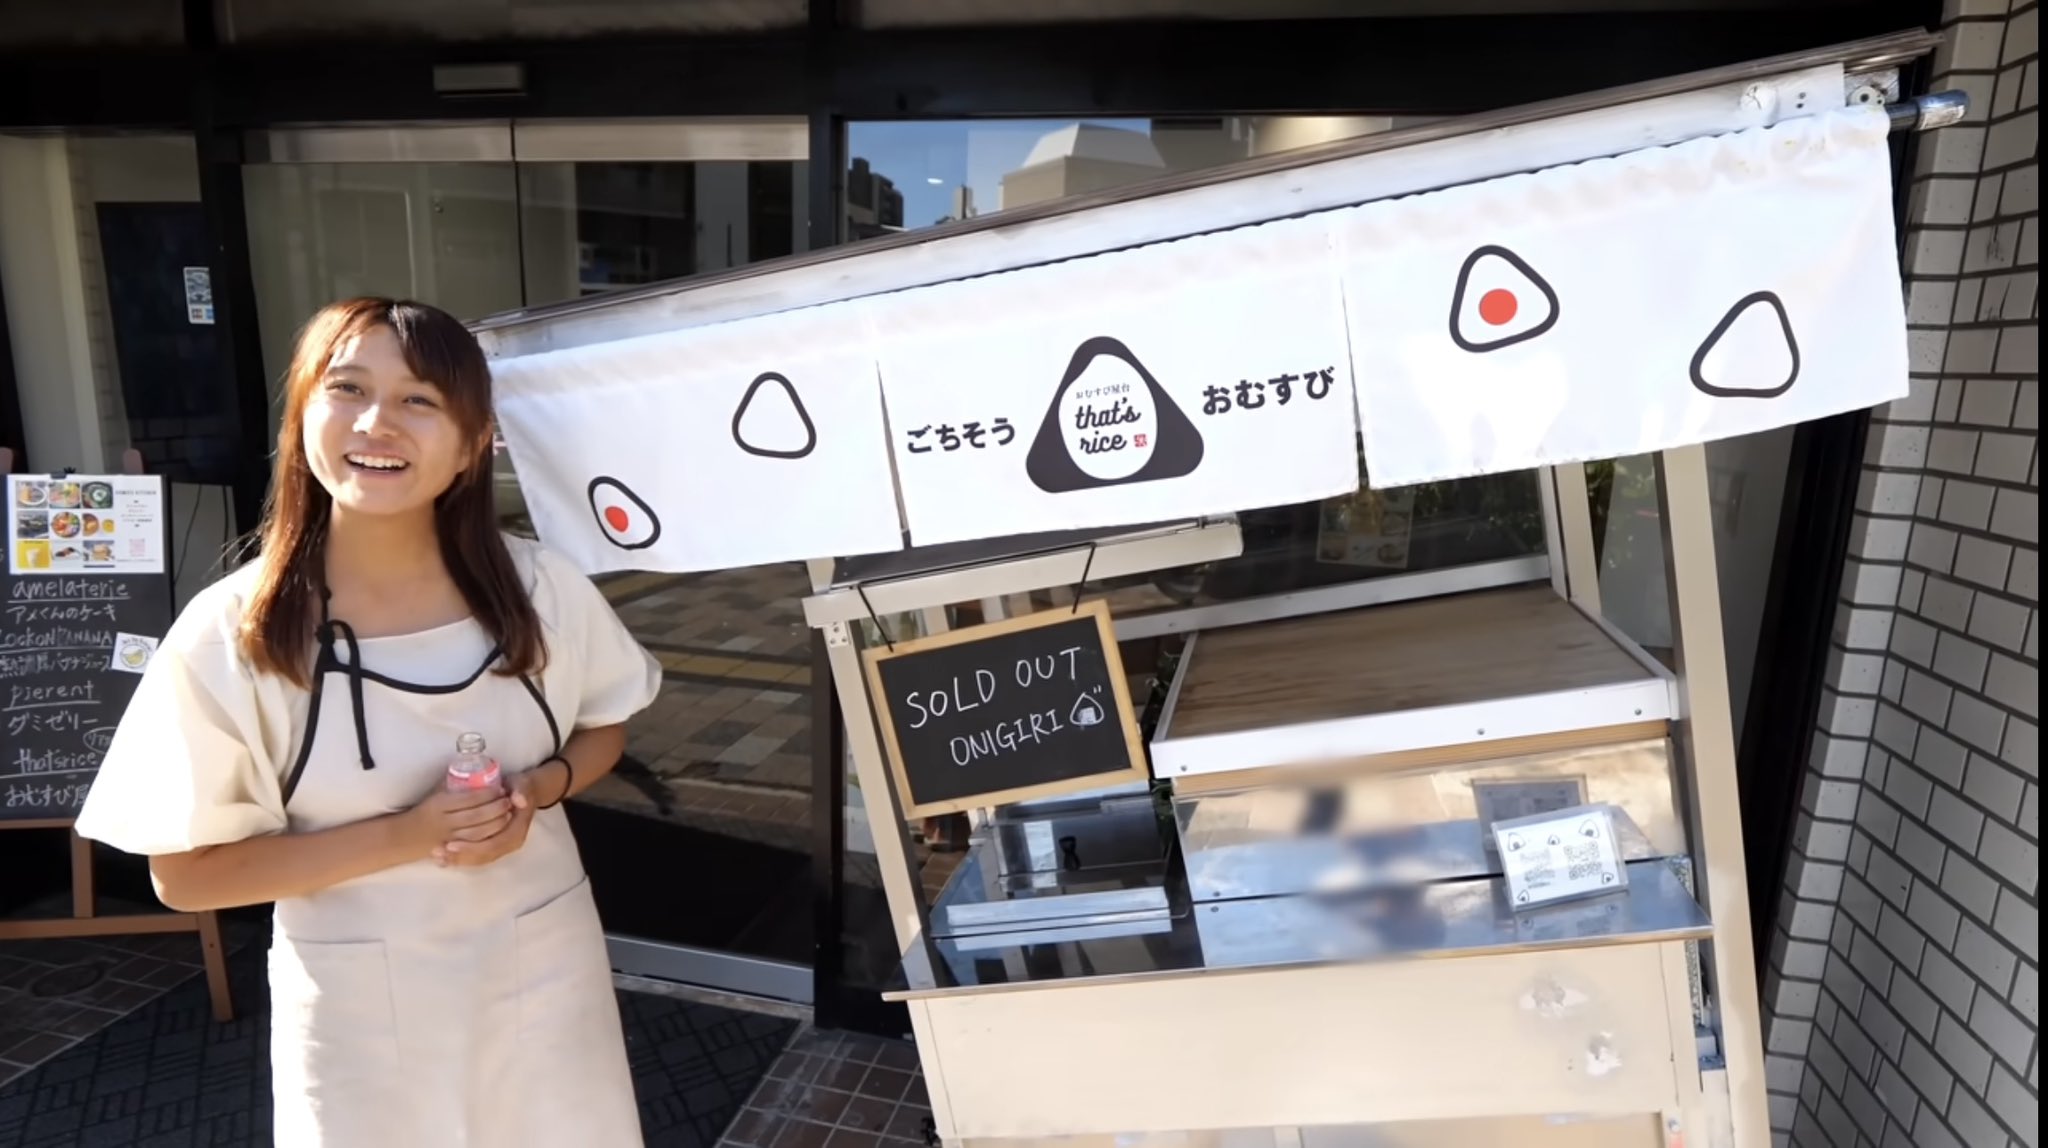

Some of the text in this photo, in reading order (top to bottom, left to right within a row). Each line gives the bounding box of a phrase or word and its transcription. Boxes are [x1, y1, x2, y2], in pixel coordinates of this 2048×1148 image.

[1202, 365, 1336, 415] おむすび
[1075, 396, 1142, 430] that's
[906, 417, 1016, 454] ごちそう
[1080, 430, 1127, 454] rice
[906, 646, 1082, 729] SOLD OUT
[949, 708, 1065, 766] ONIGIRI
